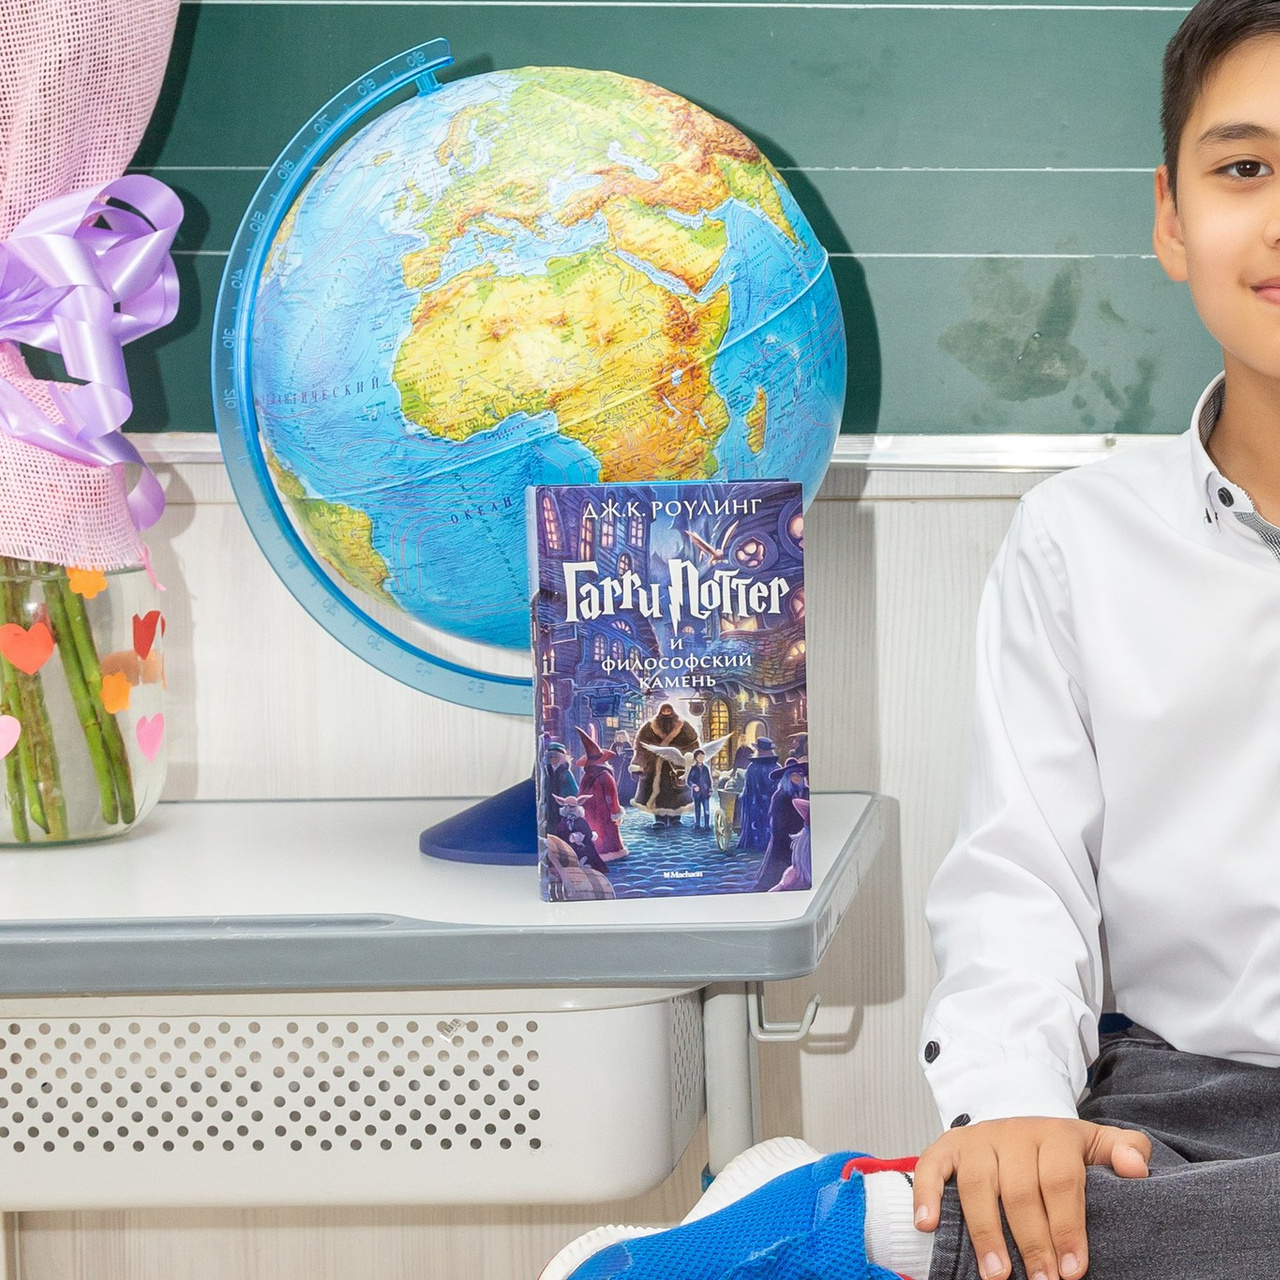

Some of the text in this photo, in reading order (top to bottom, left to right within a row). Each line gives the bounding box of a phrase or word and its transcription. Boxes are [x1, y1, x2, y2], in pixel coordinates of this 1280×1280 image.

[450, 496, 513, 524] ОКЕАН
[582, 497, 763, 521] ДЖ.К. РОУЛИНГ
[562, 561, 664, 624] Гарри
[666, 558, 791, 635] Поттер
[638, 674, 717, 690] КАМЕНЬ
